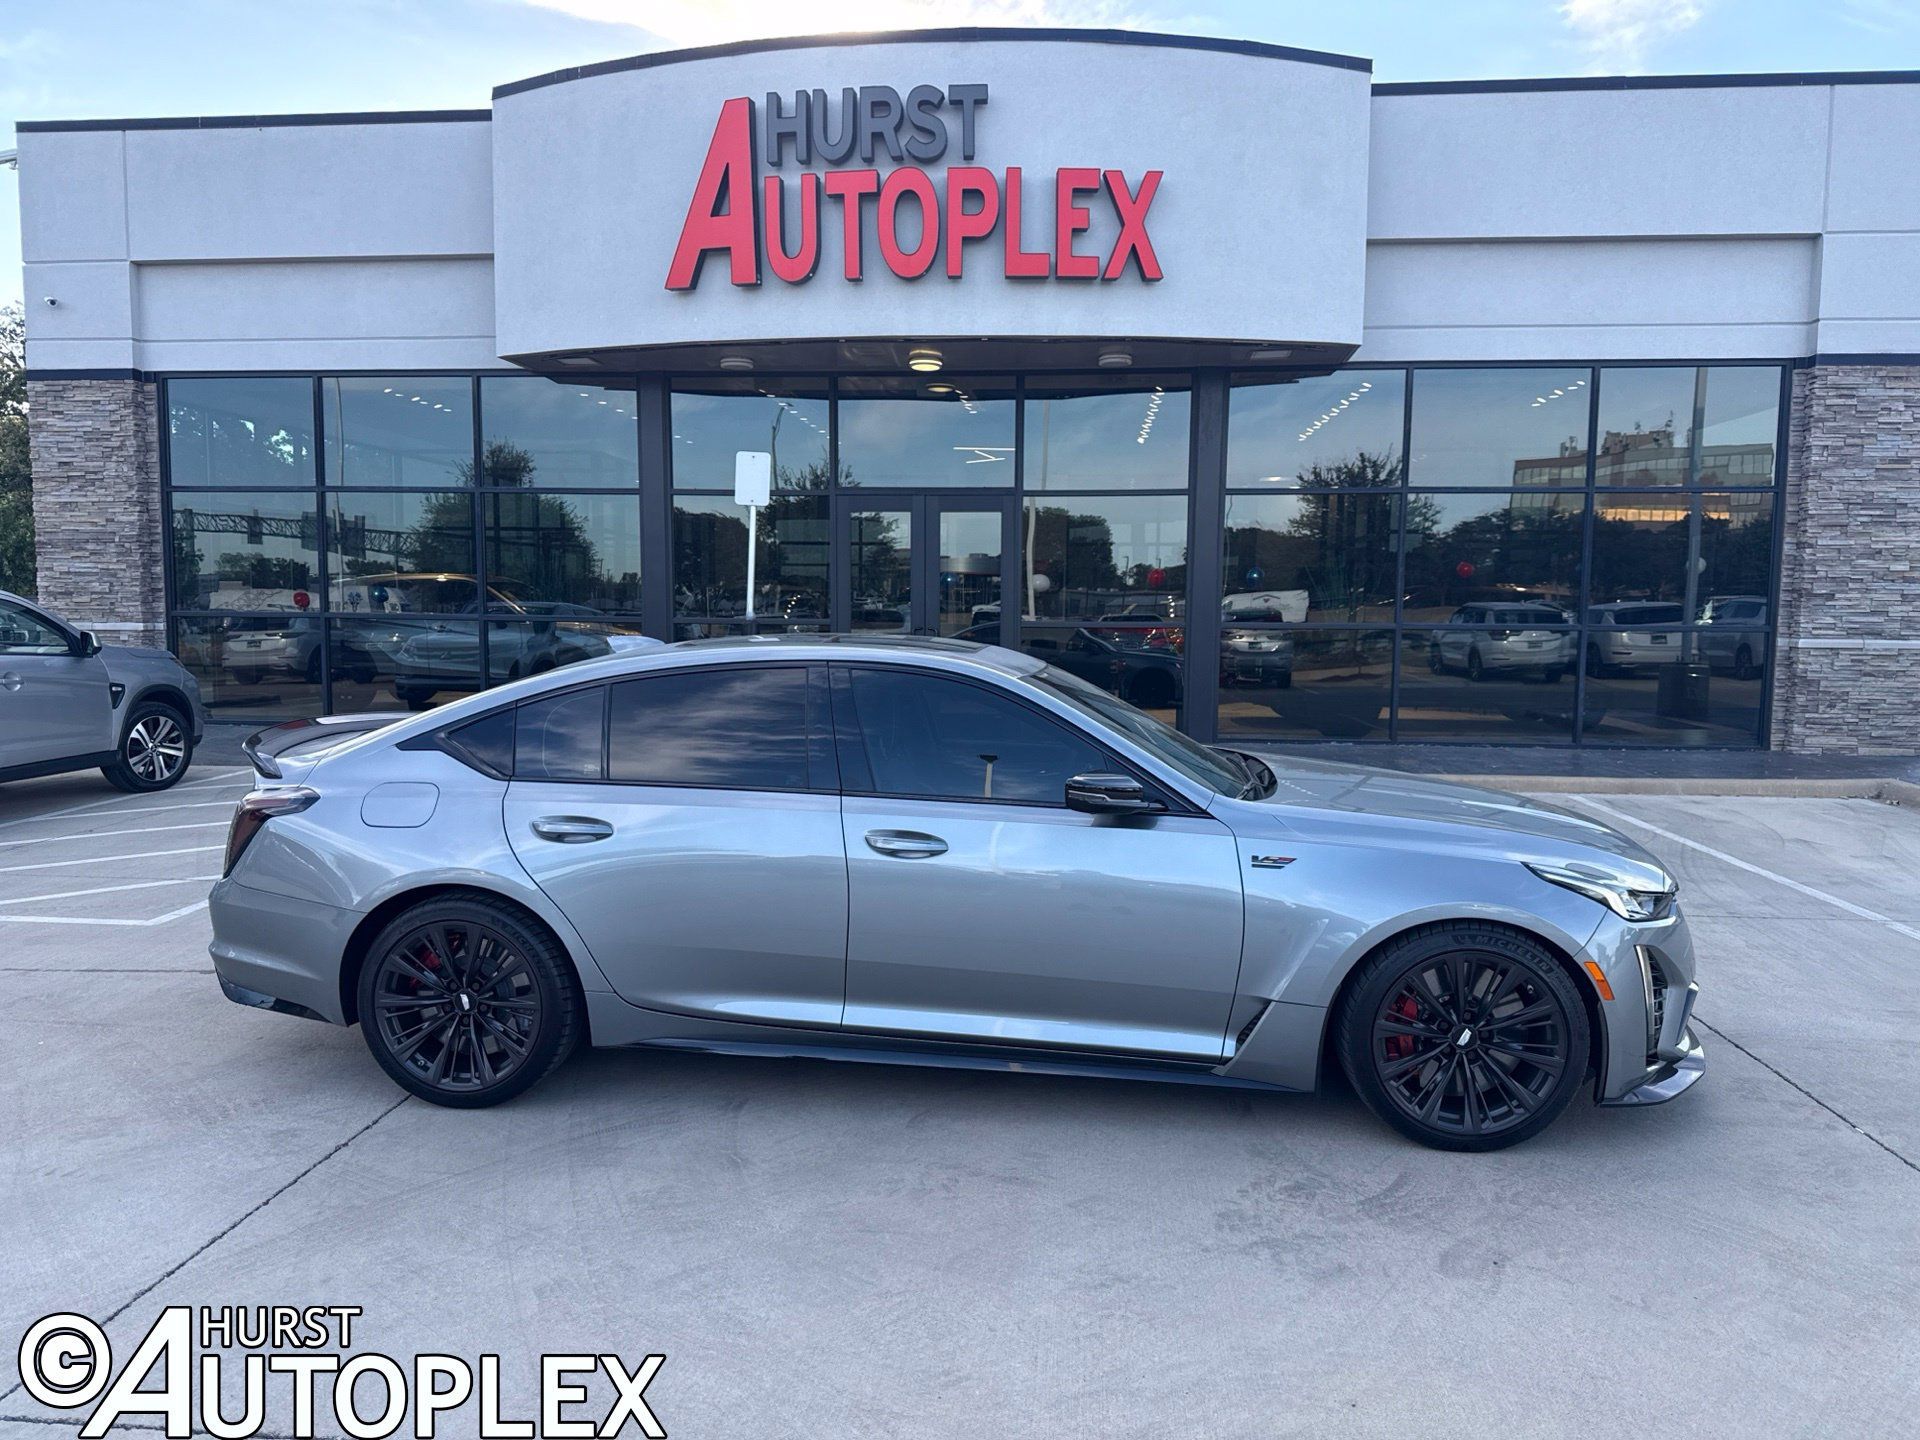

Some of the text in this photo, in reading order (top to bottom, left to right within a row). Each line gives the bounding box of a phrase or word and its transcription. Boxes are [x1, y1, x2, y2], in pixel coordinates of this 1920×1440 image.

[766, 83, 989, 166] HURST
[664, 97, 1164, 290] AUTOPLEX
[1477, 935, 1554, 973] MICHELIN
